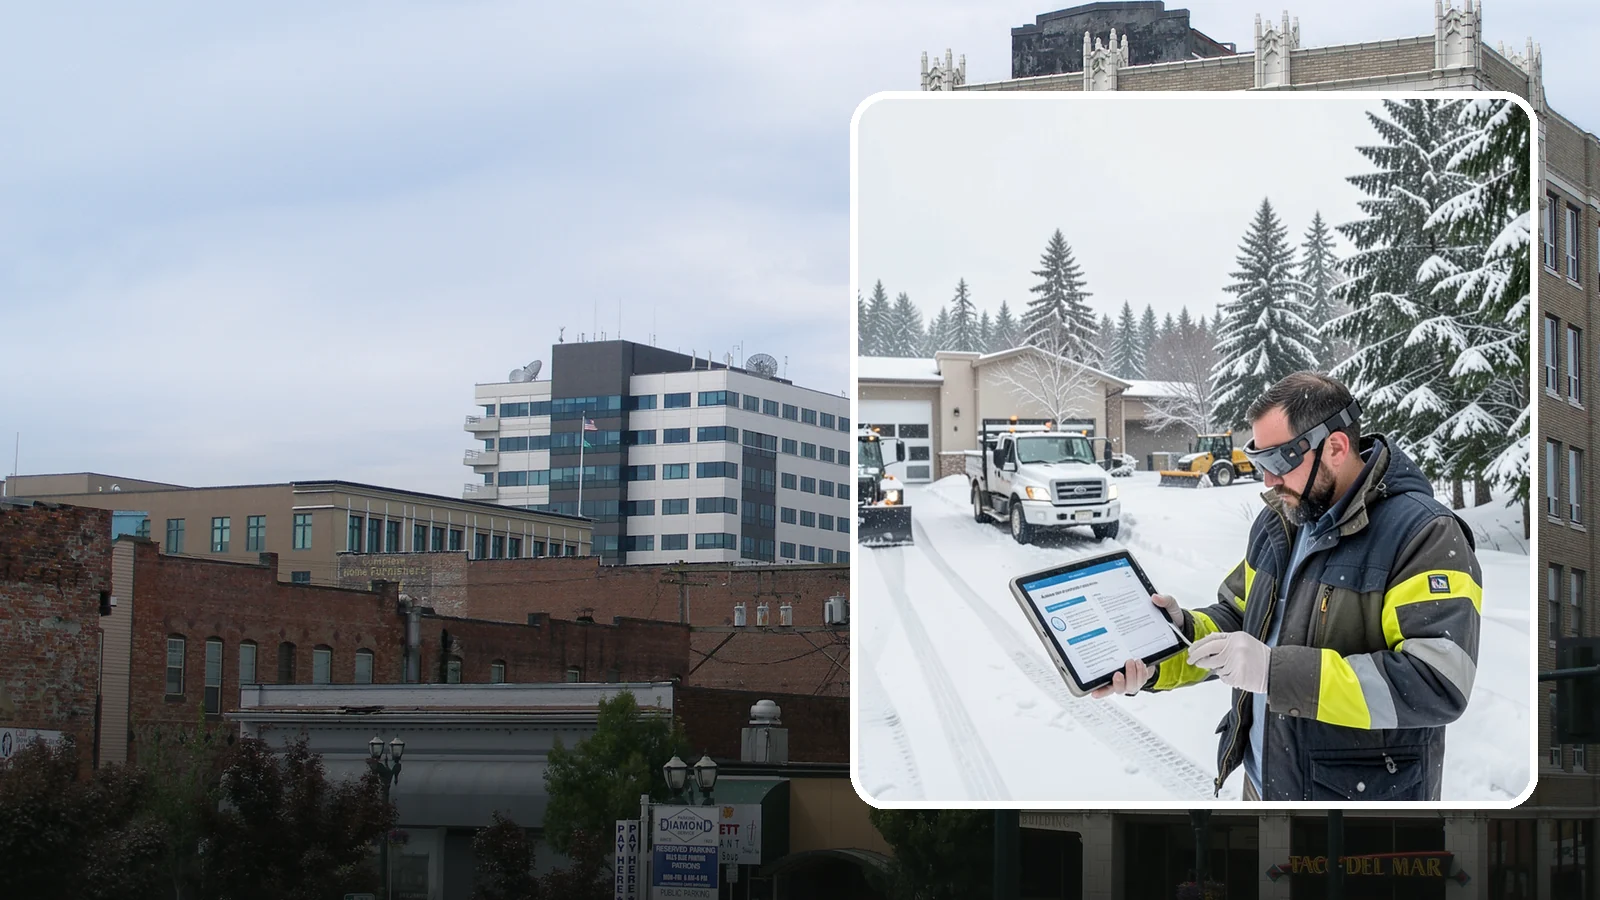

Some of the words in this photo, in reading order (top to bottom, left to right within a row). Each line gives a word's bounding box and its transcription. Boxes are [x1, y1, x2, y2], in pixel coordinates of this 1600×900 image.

[343, 568, 367, 577] Home
[370, 566, 427, 576] Furnishers
[660, 818, 713, 833] DIAMOND
[1022, 815, 1070, 828] BUILDING
[719, 824, 740, 835] ETT
[617, 825, 625, 852] PAY
[628, 824, 637, 852] PAY
[656, 845, 688, 853] RESERVED
[689, 846, 716, 854] PARKING
[721, 851, 739, 862] Soup
[671, 862, 701, 870] PATRONS
[1346, 856, 1385, 876] DEL
[1392, 857, 1443, 877] MAR
[617, 856, 625, 893] HERE
[628, 855, 637, 893] HERE
[660, 888, 681, 897] PUBLIC
[683, 889, 710, 898] PARKING
